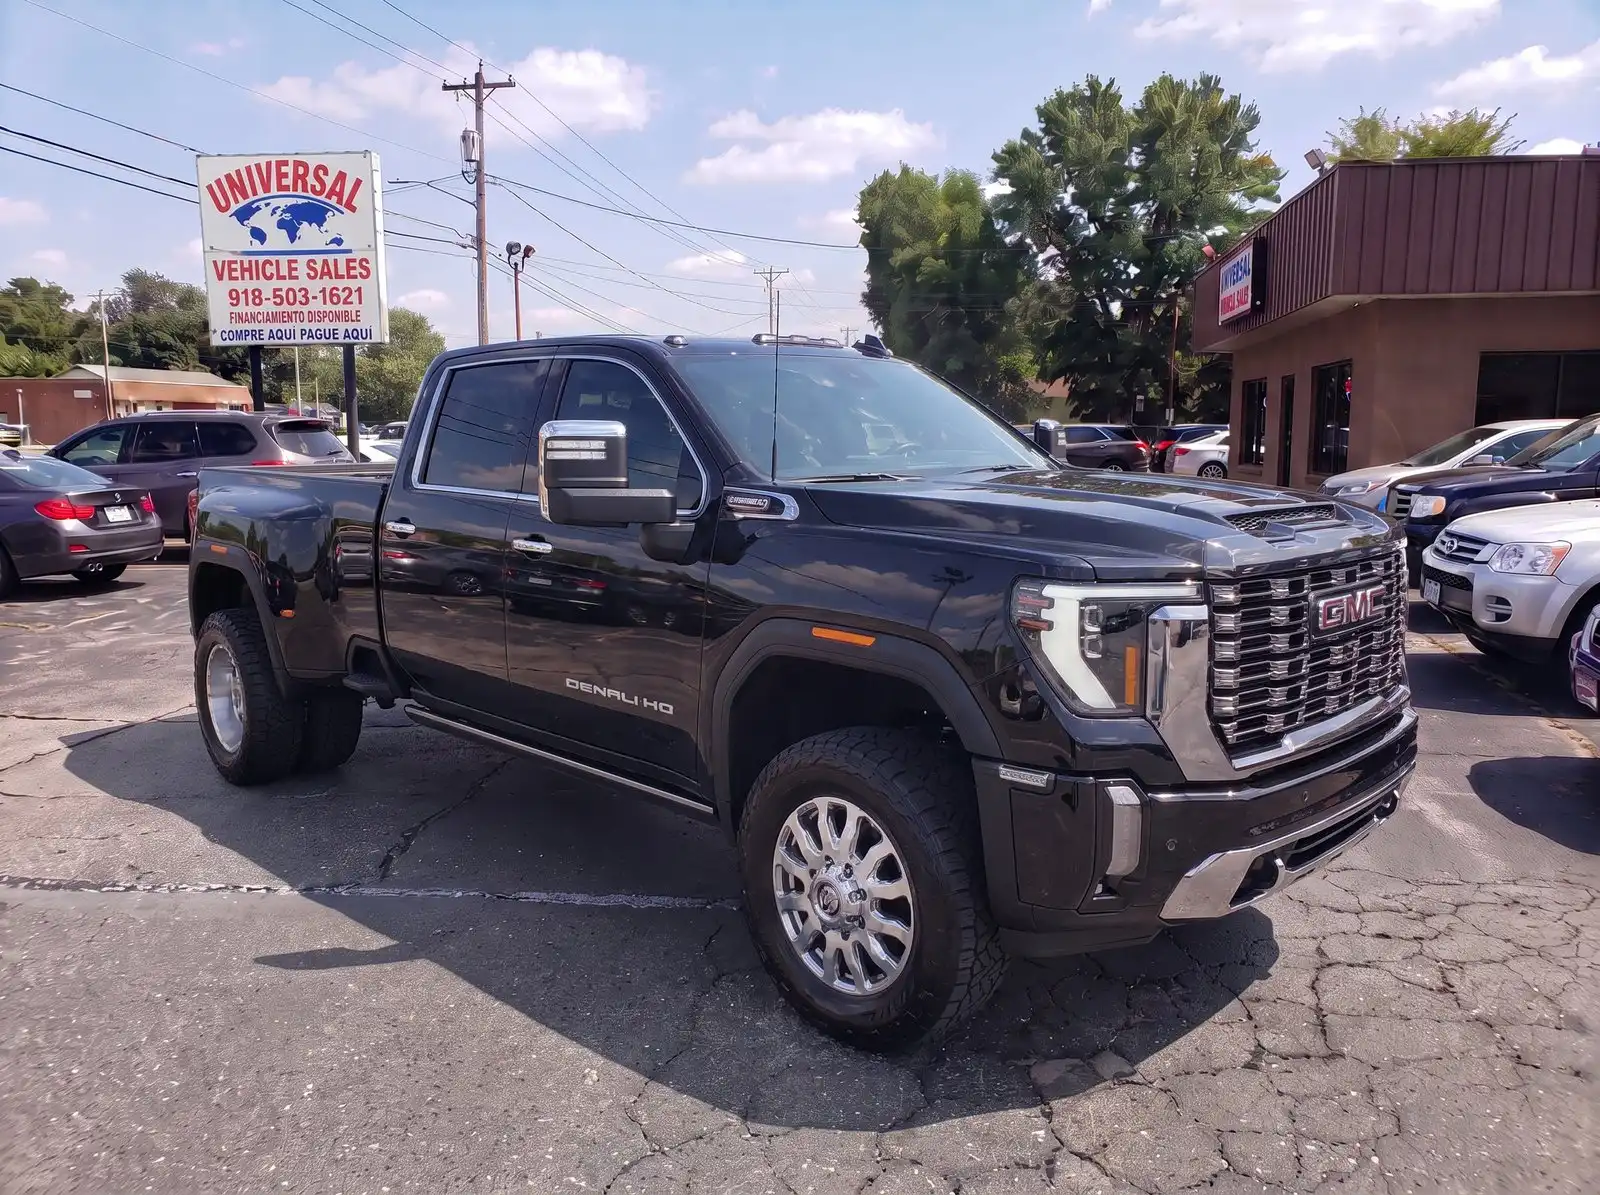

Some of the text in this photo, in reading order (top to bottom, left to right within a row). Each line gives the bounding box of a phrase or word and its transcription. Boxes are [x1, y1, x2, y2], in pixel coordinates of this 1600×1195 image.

[205, 159, 363, 214] UNIVERSAL
[212, 257, 371, 281] VEHICLE SALES
[228, 286, 363, 307] 918-503-1621
[229, 309, 361, 324] FINANCIAMIENTO DISPONIBLE
[220, 328, 264, 342] COMPRE
[300, 327, 339, 341] PAGUE
[1318, 584, 1387, 630] GMC
[565, 677, 674, 715] DENALI HD
